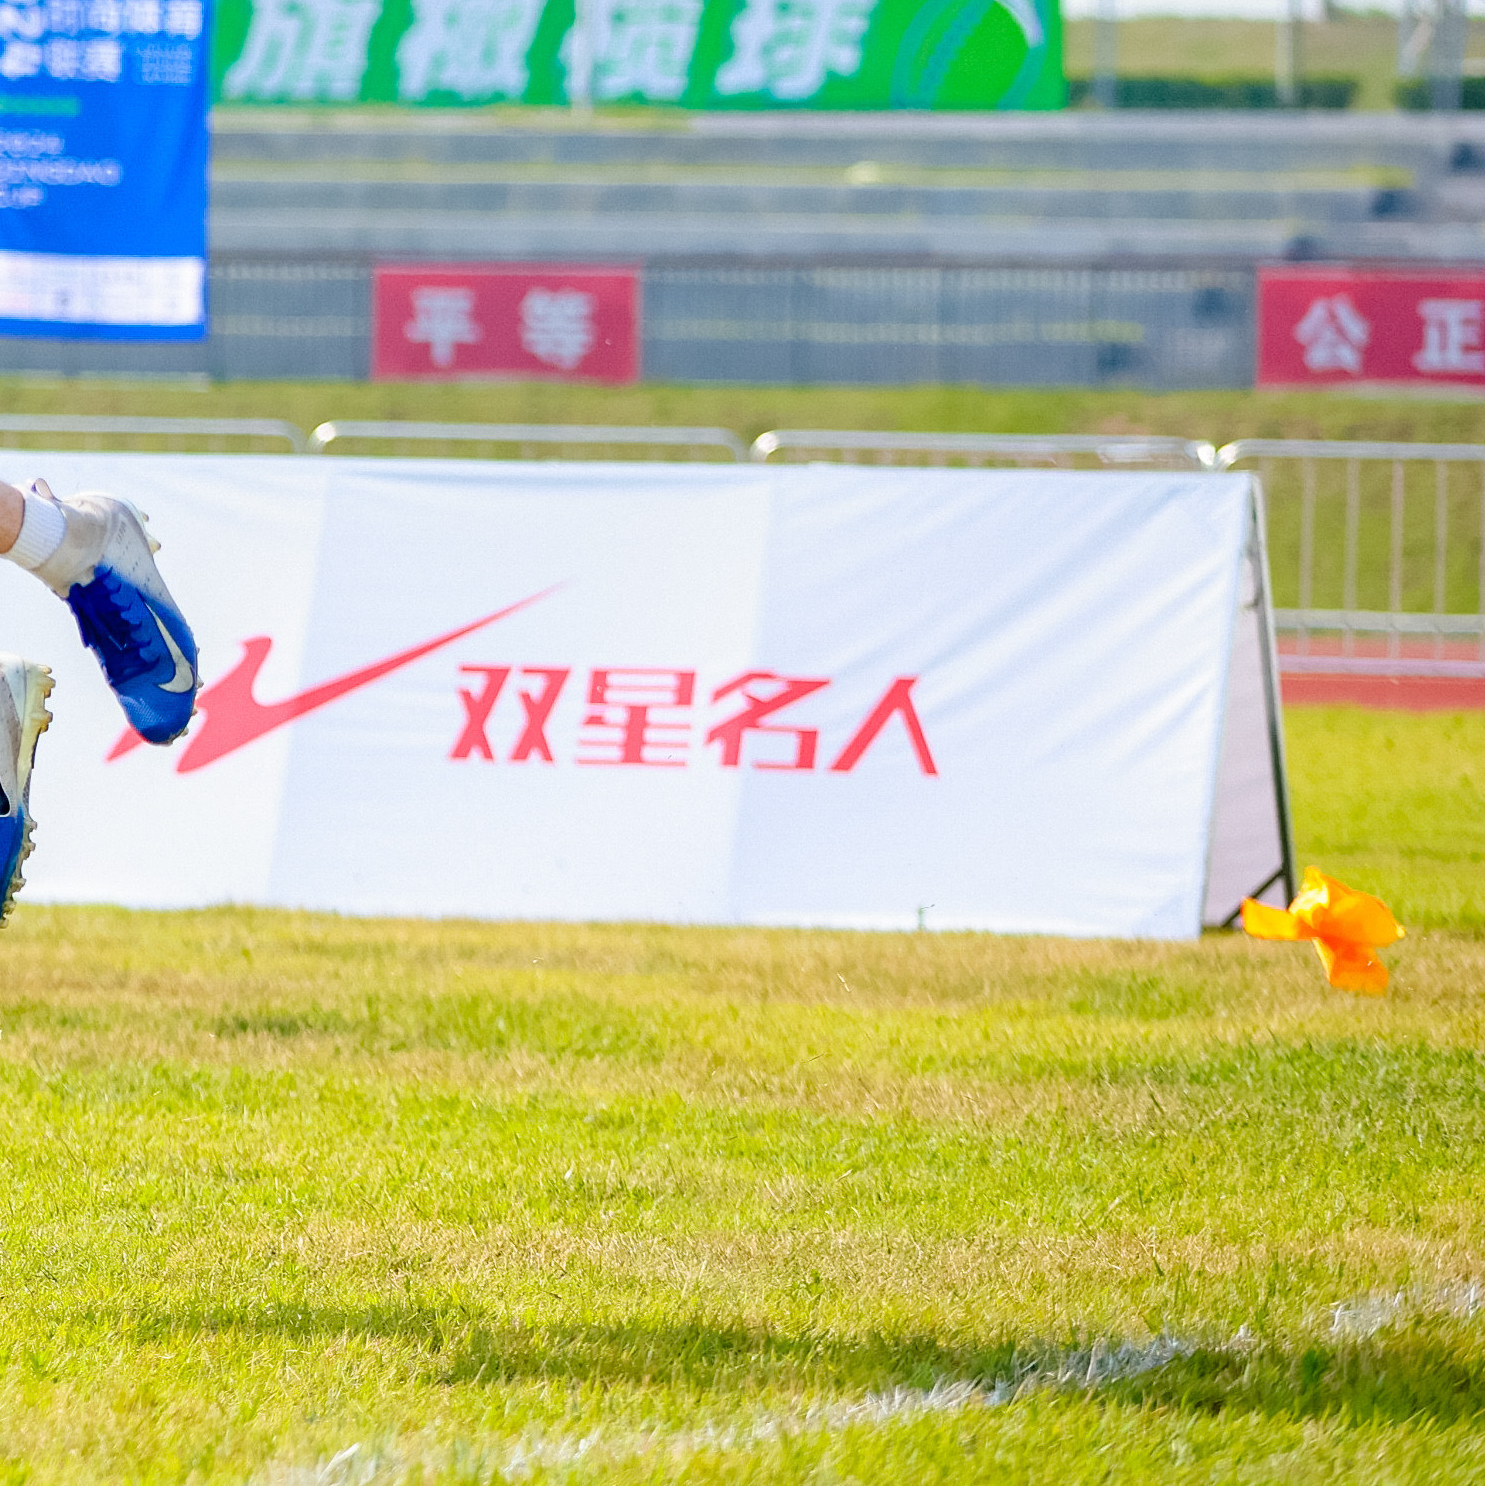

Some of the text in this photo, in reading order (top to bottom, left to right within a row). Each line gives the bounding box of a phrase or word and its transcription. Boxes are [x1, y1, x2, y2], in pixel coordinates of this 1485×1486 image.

[406, 286, 596, 370] 平等
[1294, 293, 1485, 375] 公正
[450, 664, 938, 776] 双星名人
